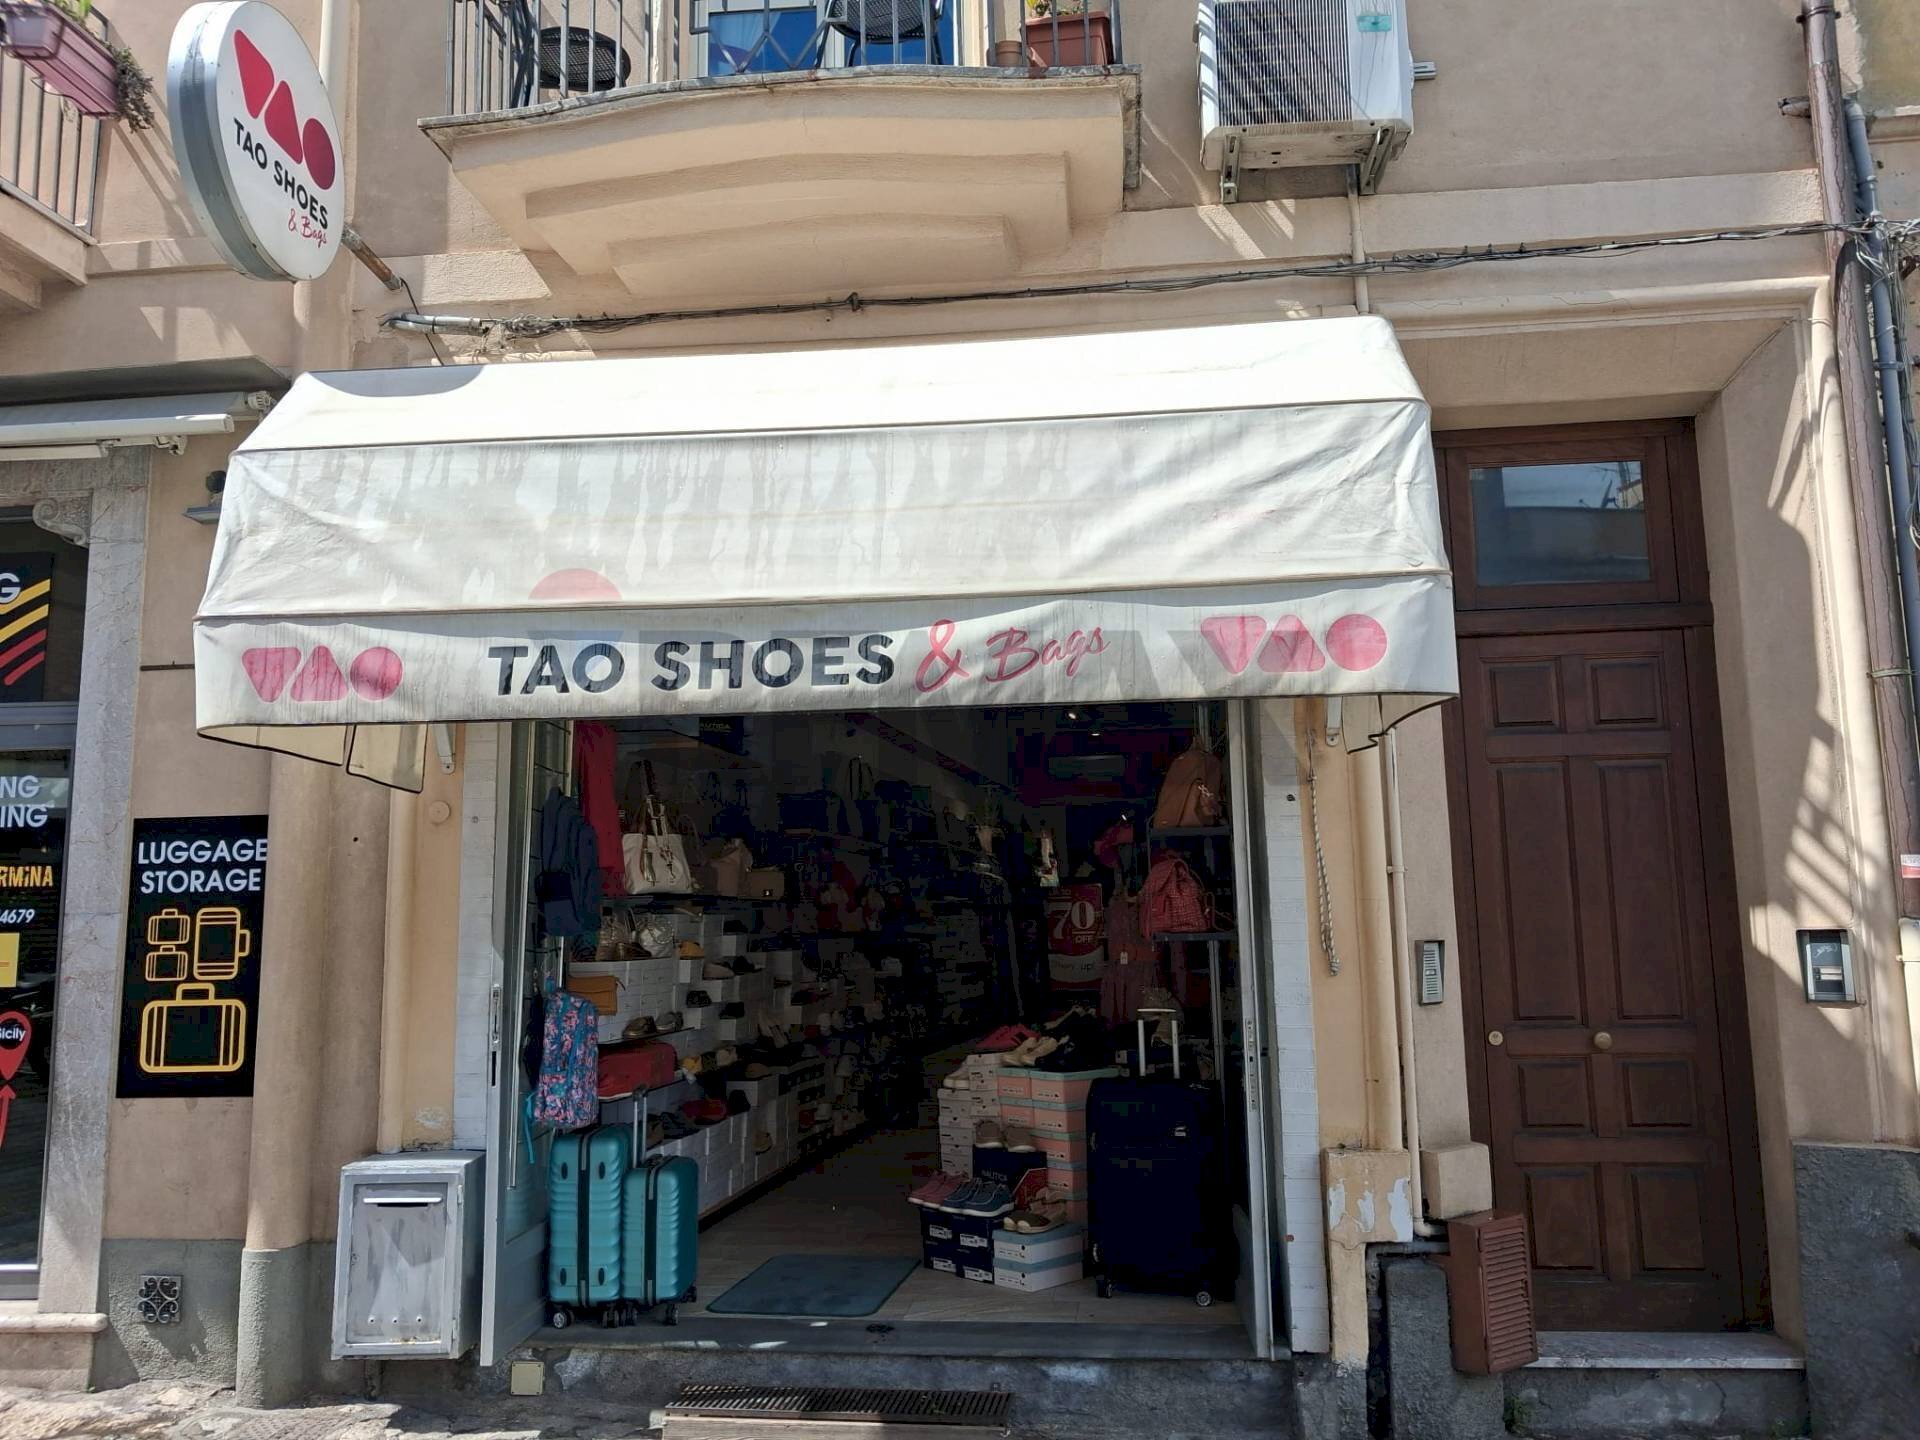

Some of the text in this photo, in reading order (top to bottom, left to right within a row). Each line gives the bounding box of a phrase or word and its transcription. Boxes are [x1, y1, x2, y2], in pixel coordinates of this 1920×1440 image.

[233, 117, 329, 230] TAO SHOES
[287, 208, 328, 248] & Bags
[488, 619, 1111, 696] TAO SHOES & Bags
[138, 839, 268, 864] LUGGAGE
[140, 868, 261, 893] STORAGE
